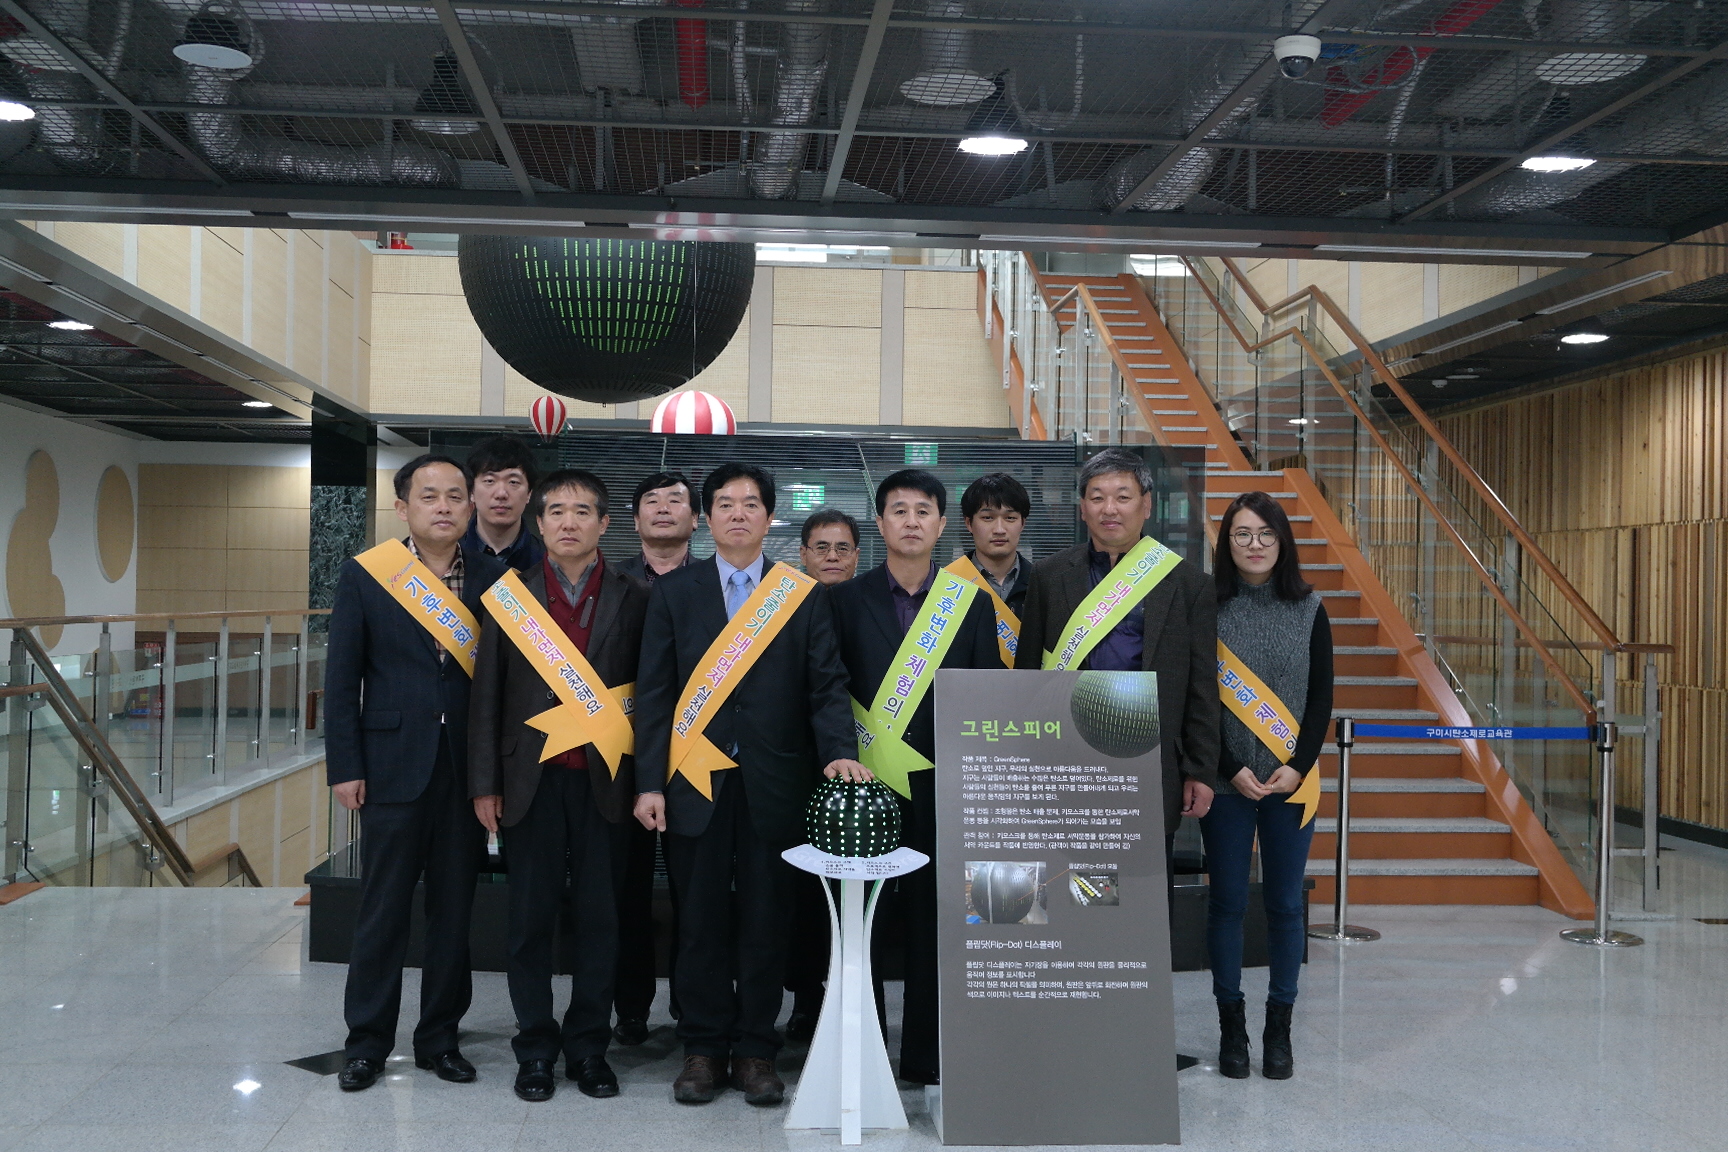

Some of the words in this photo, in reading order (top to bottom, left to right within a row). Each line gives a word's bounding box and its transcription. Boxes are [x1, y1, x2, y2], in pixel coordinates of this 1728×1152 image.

[404, 575, 475, 647] 기후변화
[745, 576, 796, 637] 탄소줄이기
[916, 580, 964, 654] 기후변화
[1084, 580, 1133, 628] 내가먼저
[520, 617, 566, 665] 내가먼저
[559, 663, 603, 716] 실천해요
[706, 633, 753, 688] 내가먼저
[674, 685, 712, 738] 실천해요
[961, 720, 1060, 741] 그린스피어
[1426, 728, 1513, 738] 구미시탄소제로교육관
[1025, 941, 1062, 949] 디스플레이
